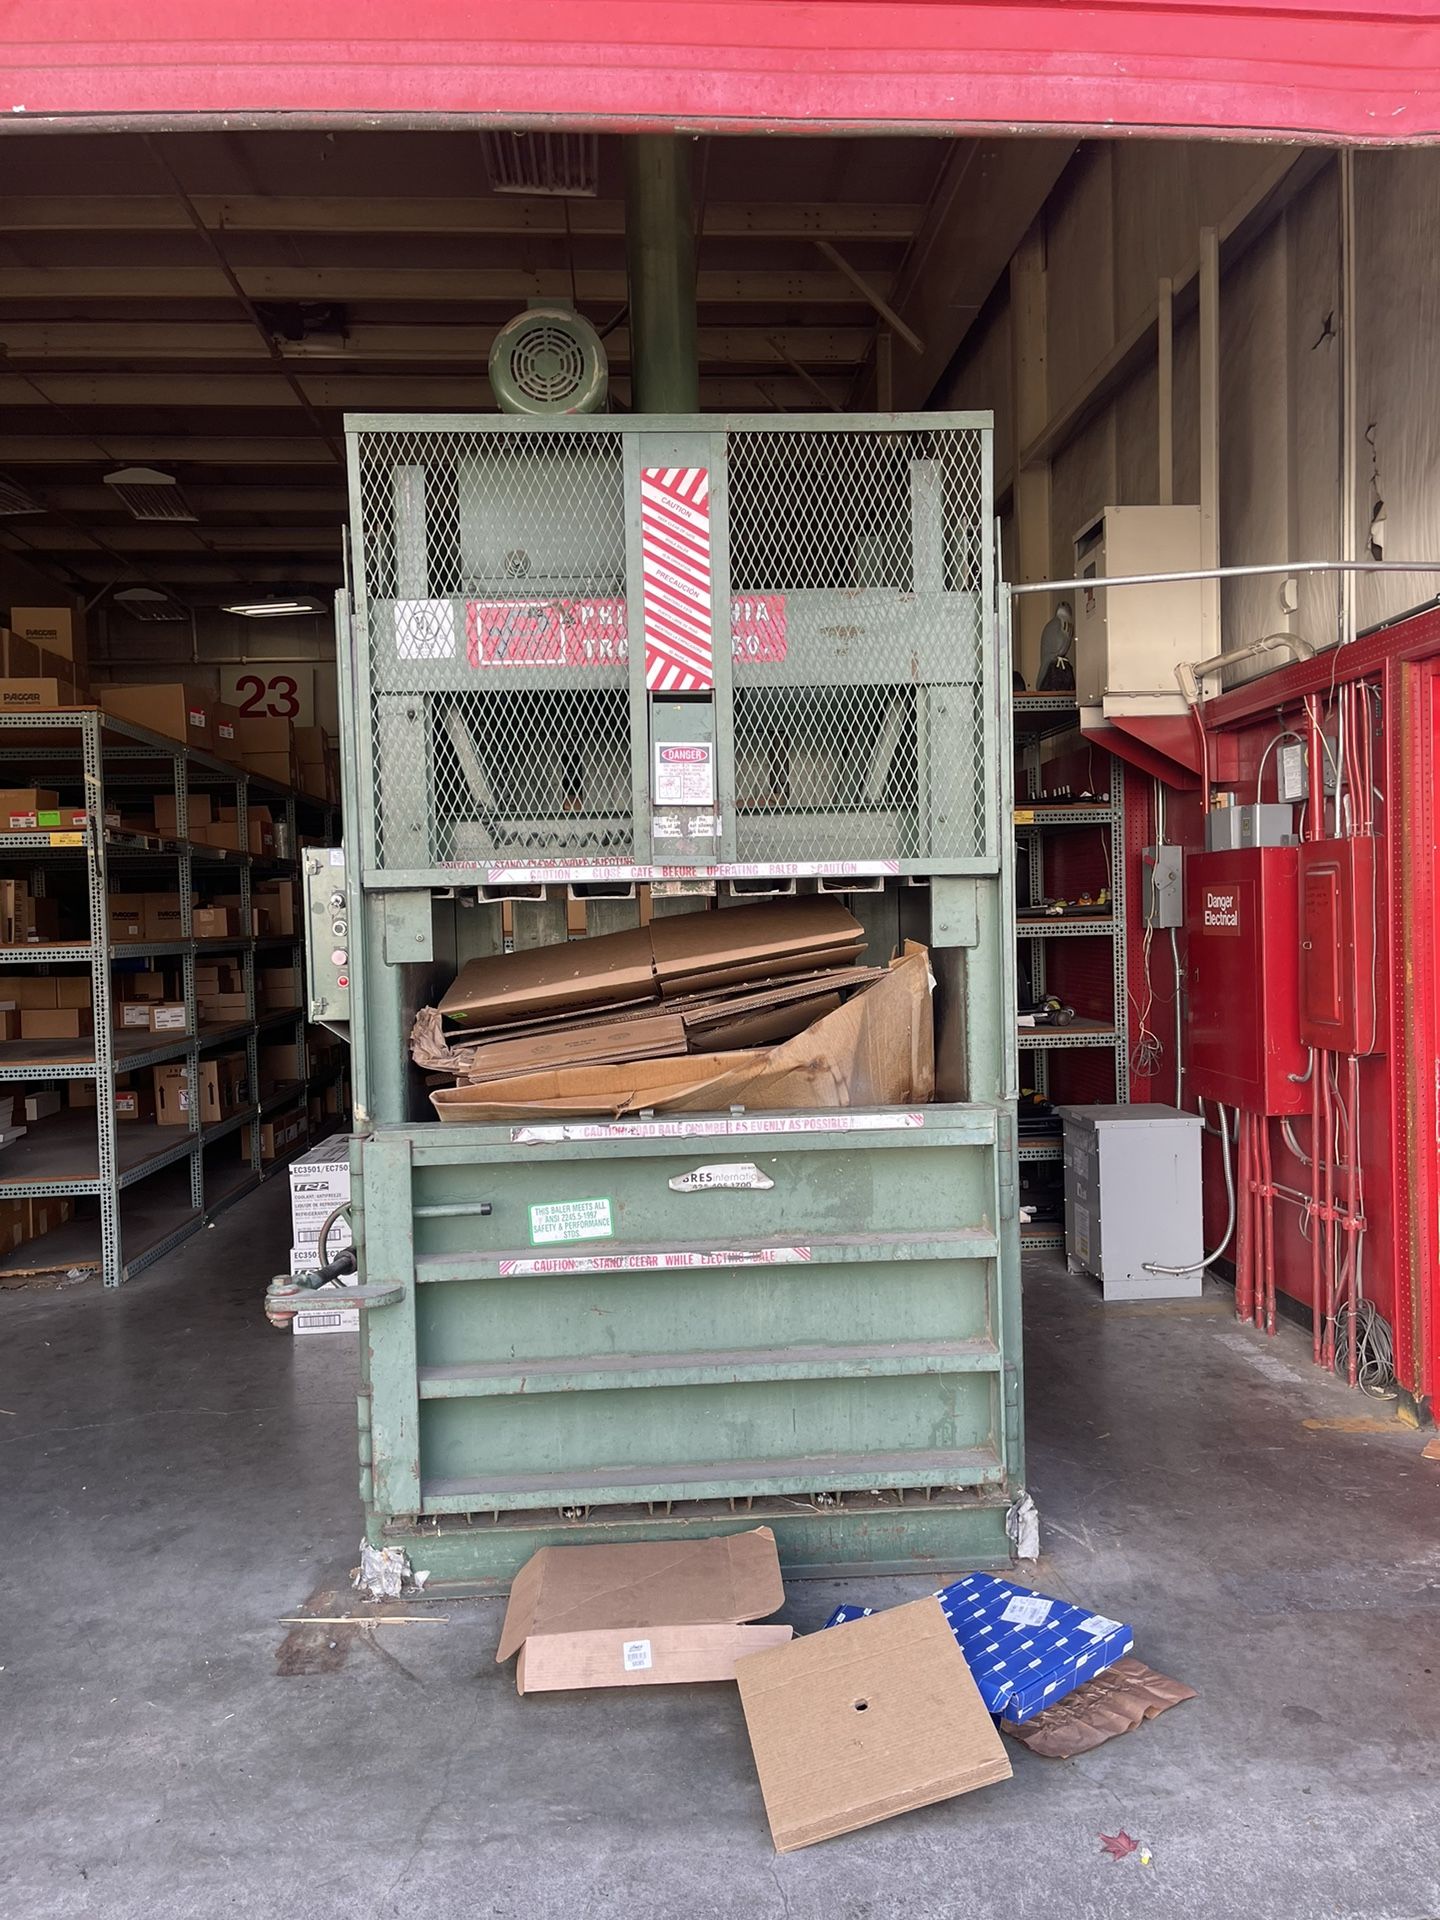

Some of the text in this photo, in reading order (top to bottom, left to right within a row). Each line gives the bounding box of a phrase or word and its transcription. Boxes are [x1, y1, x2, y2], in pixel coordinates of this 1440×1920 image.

[661, 496, 692, 518] CAUTION
[656, 569, 700, 598] PRECAUCIÓN
[236, 675, 300, 718] 23
[668, 750, 702, 760] DANGER
[530, 869, 571, 880] CAUTION
[592, 867, 621, 878] CLOSE
[631, 866, 653, 877] GATE
[707, 864, 758, 876] OPERATING
[769, 863, 798, 874] BALER
[818, 862, 857, 874] CAUTION
[1207, 893, 1233, 911] Danger
[1205, 910, 1237, 925] Electrical
[658, 1122, 683, 1135] BALE
[735, 1119, 748, 1131] AS
[751, 1118, 786, 1131] EVENLY
[788, 1118, 800, 1130] AS
[804, 1117, 848, 1129] POSSIBLE
[535, 1201, 606, 1216] THIS BALER MEETS ALL
[533, 1218, 610, 1233] SAFETY & PERFORMANCE
[545, 1214, 560, 1223] ANSI
[593, 1257, 623, 1269] STAND
[629, 1255, 658, 1268] CLEAR
[665, 1254, 694, 1266] WHILE
[701, 1253, 745, 1265] EJECTING
